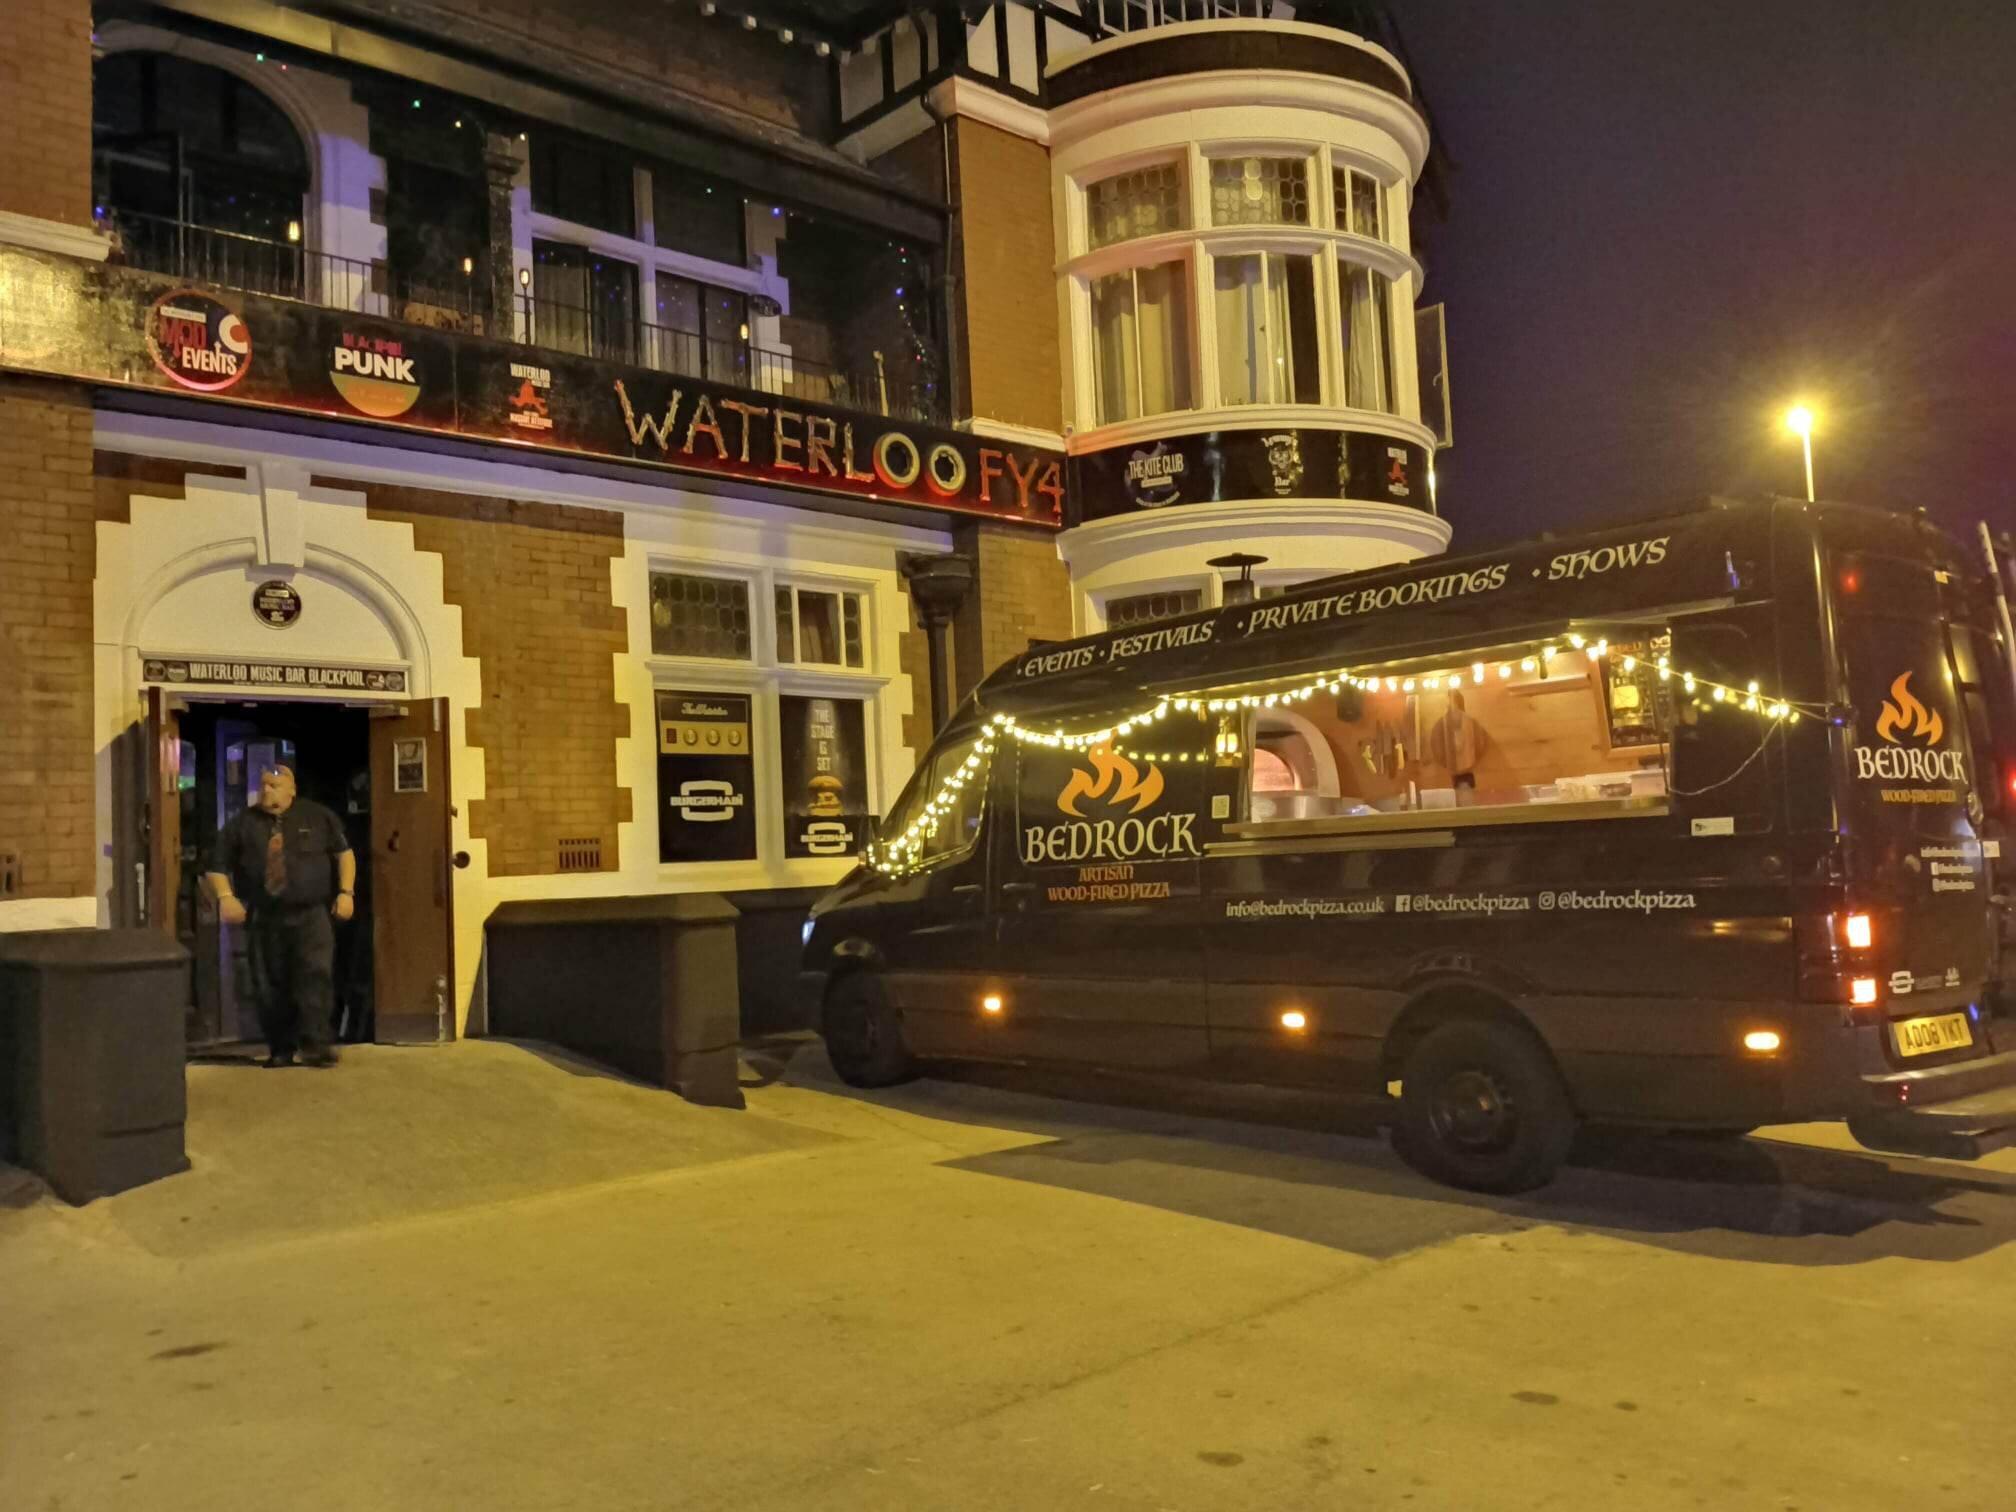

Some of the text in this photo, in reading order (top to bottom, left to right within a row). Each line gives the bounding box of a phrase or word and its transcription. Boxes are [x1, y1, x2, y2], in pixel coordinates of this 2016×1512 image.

[182, 341, 237, 376] EVENTS
[335, 346, 416, 383] PUNK
[614, 379, 1064, 513] WATERLOO FY4
[1128, 452, 1184, 480] THE KITE CLUB
[1025, 536, 1671, 677] EVENTS FESTIVALS PRIVATE BOOKINGS SHOWS
[189, 662, 247, 681] WATERLOO
[250, 665, 283, 683] MUSIC
[285, 667, 306, 684] BAR
[308, 668, 365, 687] BLACKPOOL
[816, 757, 832, 771] SET
[1854, 745, 1968, 785] BEDROCK
[1024, 812, 1202, 863] BEDROCK
[1079, 864, 1134, 882] ARTISAN
[1048, 882, 1170, 901] WOOD-FIRED PIZZA
[1226, 889, 1697, 919] info@bedrockpizza.co.uk @bedrockpizza @bedrockpizza
